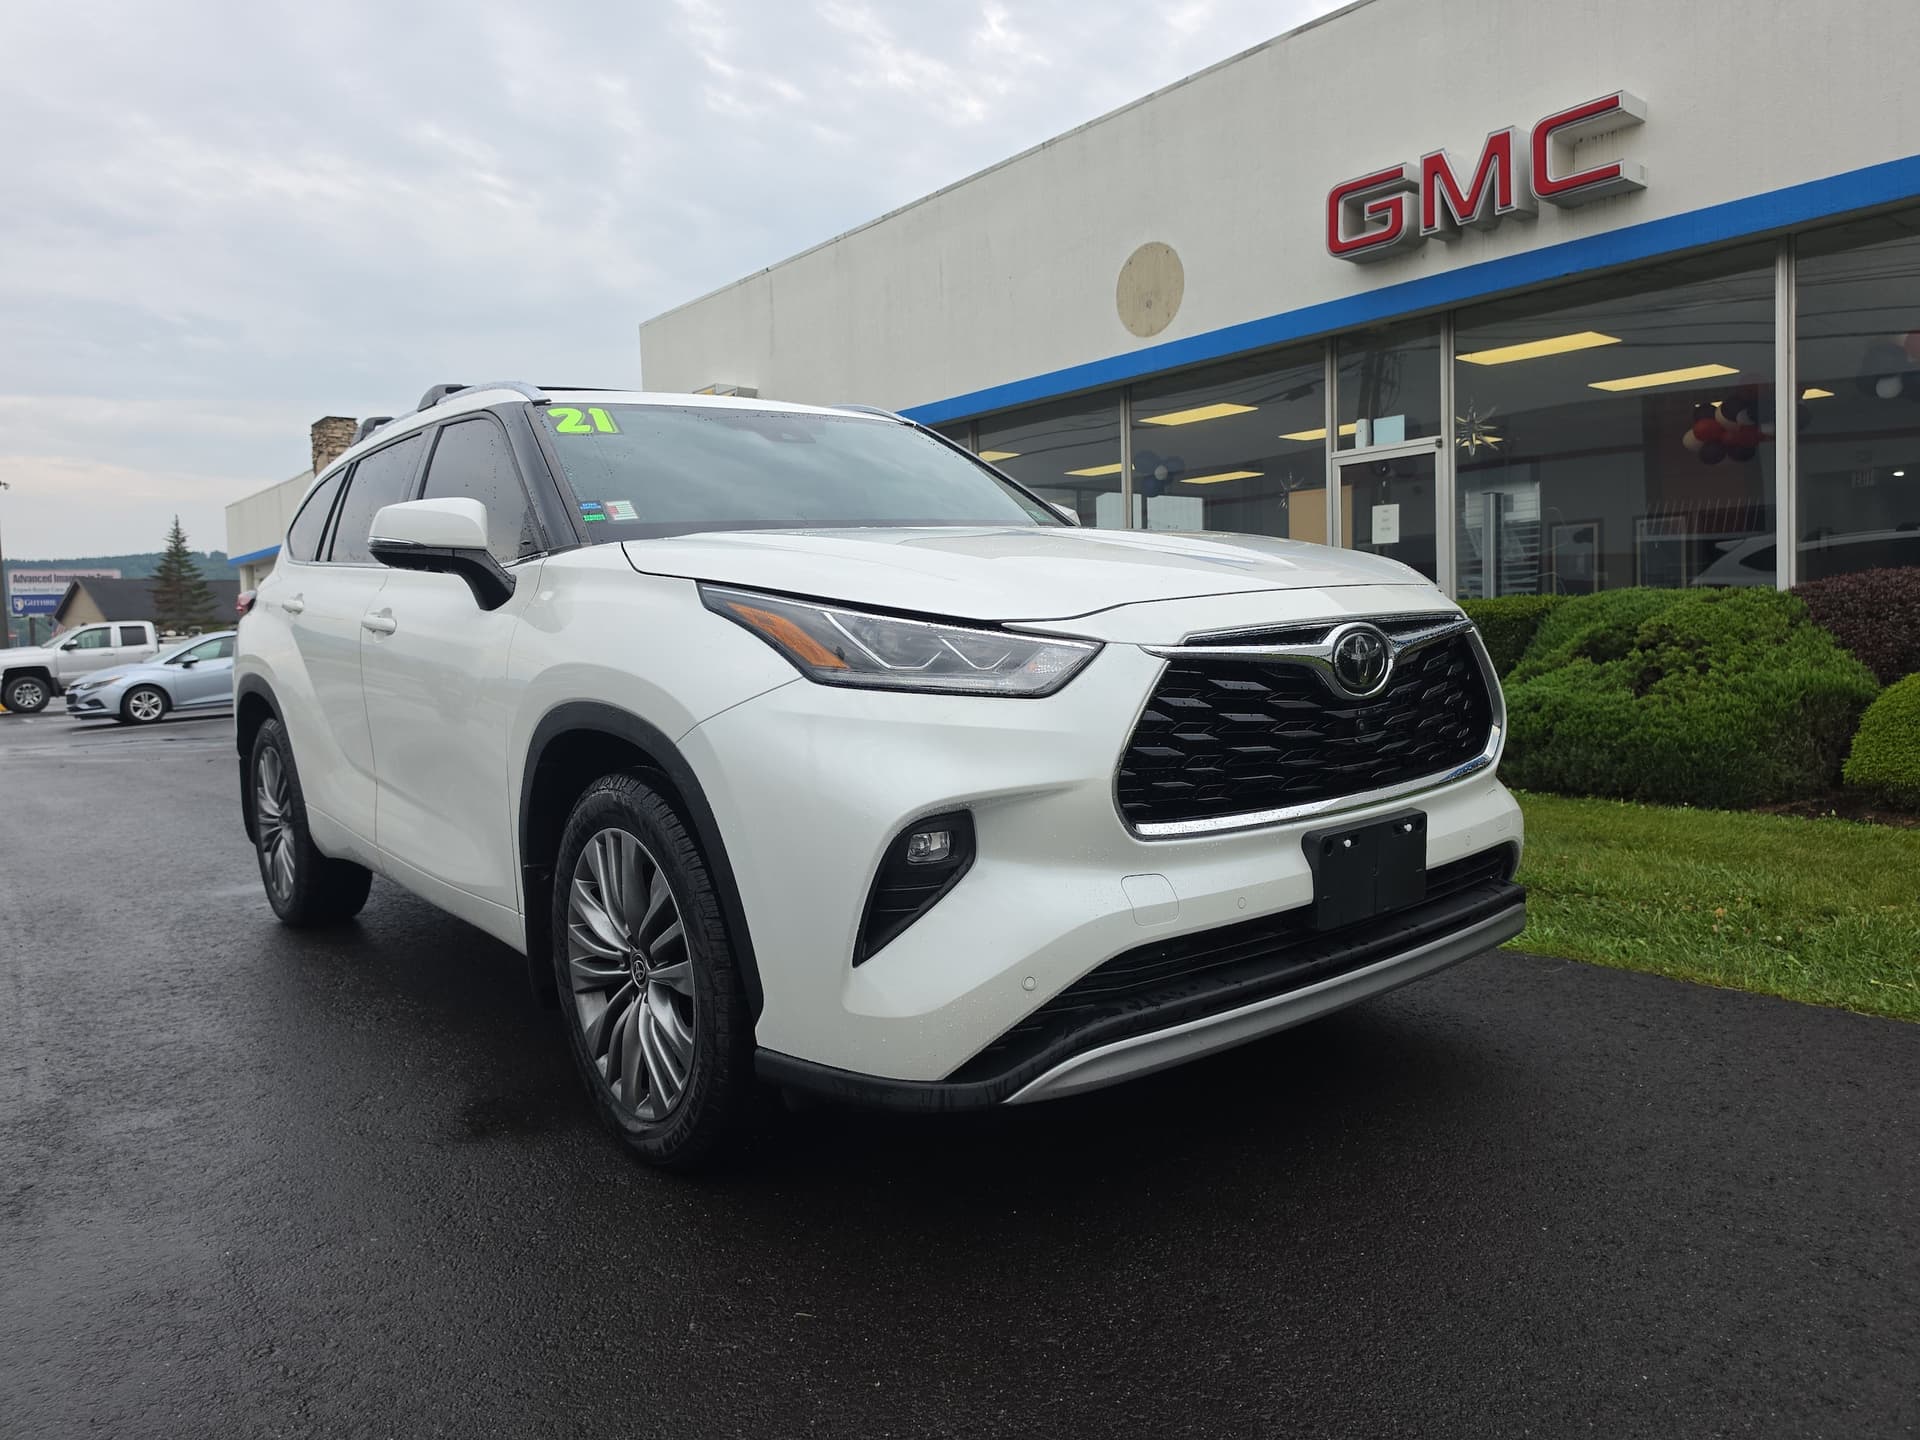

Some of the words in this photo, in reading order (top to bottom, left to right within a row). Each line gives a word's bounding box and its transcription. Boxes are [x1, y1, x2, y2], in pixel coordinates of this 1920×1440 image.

[1327, 90, 1647, 263] GMC
[547, 408, 621, 433] 21
[13, 574, 53, 584] Advanced
